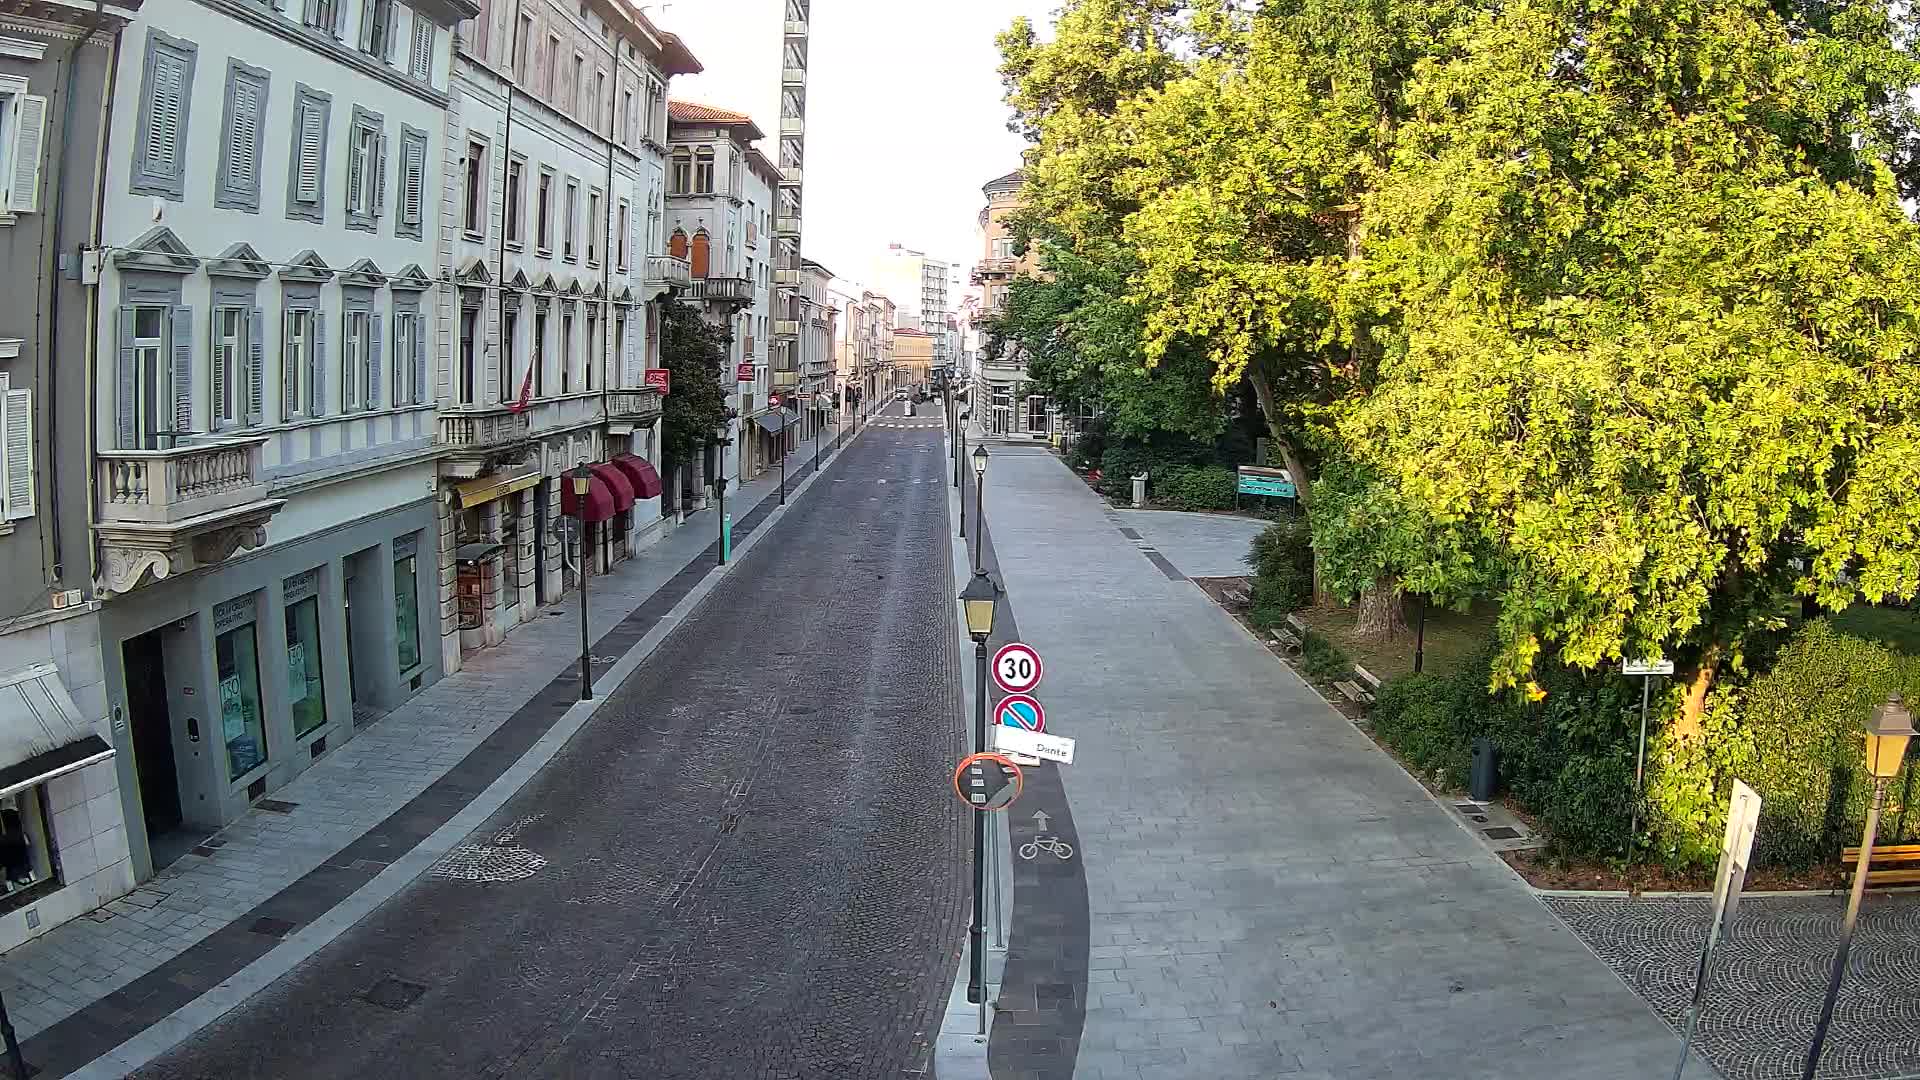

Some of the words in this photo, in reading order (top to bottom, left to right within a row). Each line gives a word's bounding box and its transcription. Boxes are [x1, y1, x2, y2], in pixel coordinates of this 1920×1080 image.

[1005, 658, 1031, 679] 30
[220, 678, 240, 700] 130
[1036, 743, 1067, 757] Dante
